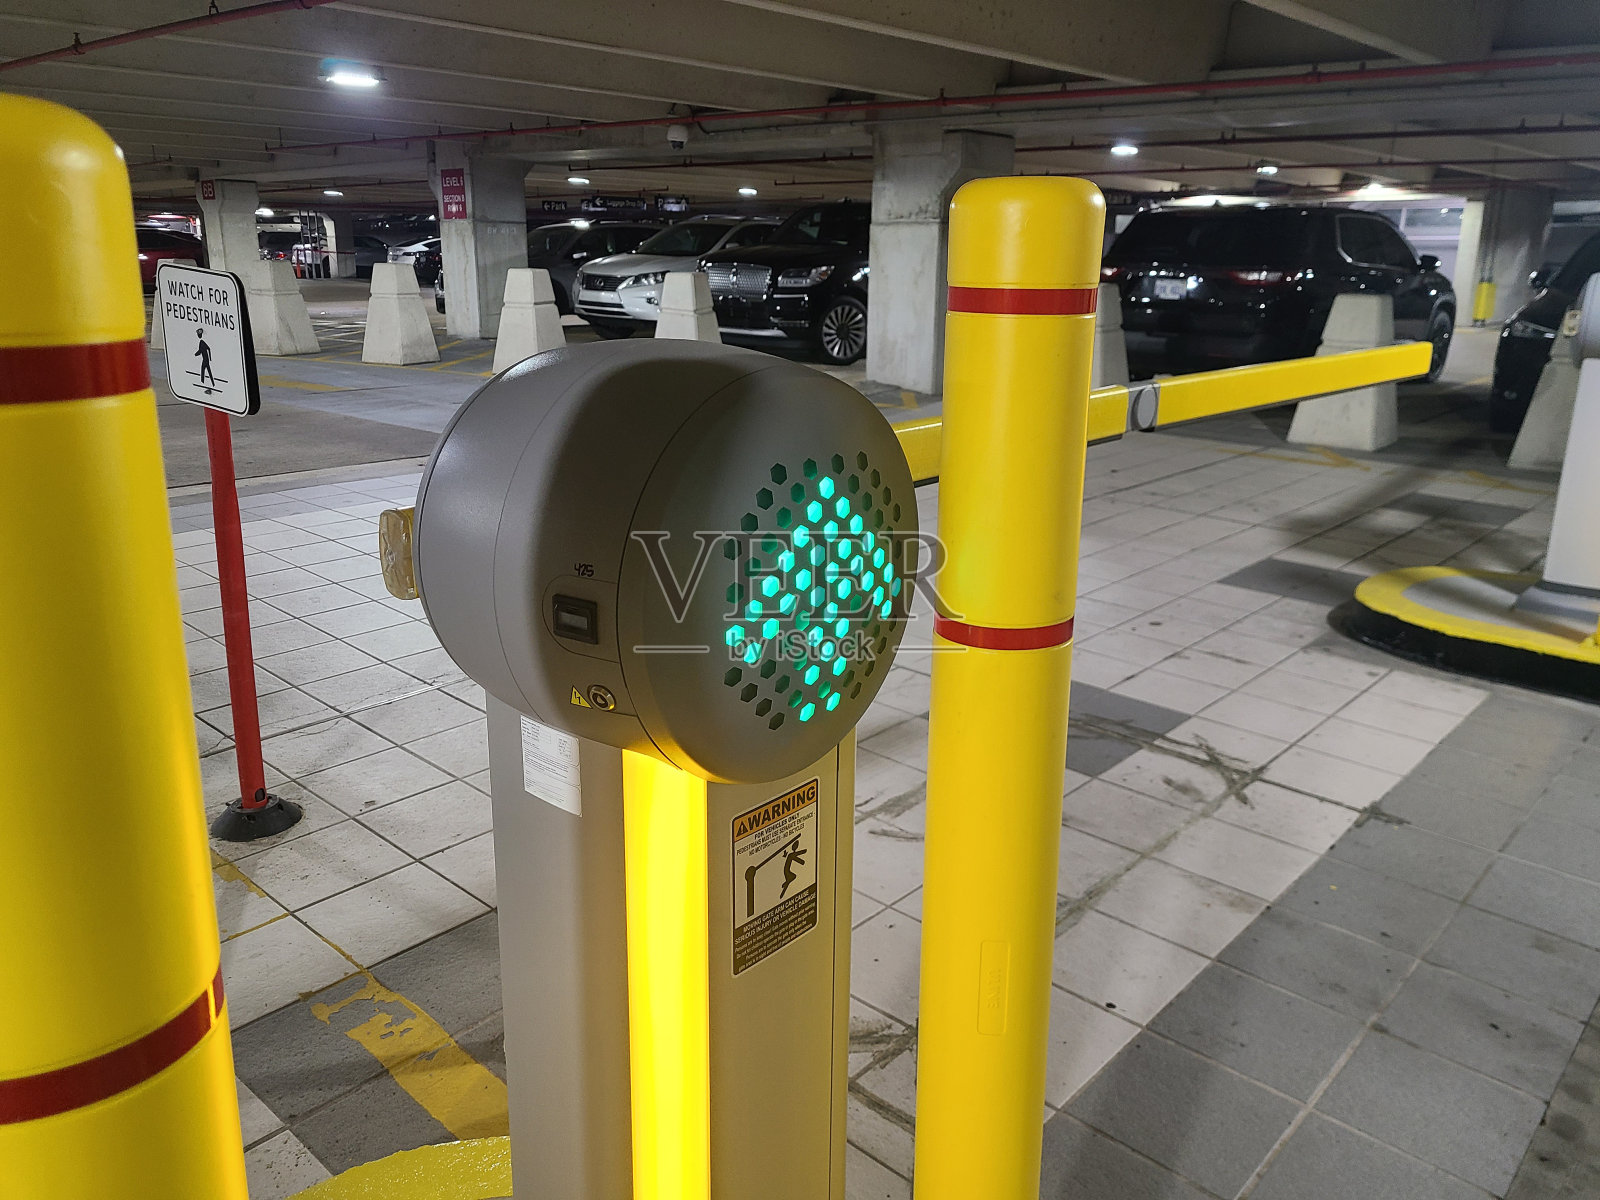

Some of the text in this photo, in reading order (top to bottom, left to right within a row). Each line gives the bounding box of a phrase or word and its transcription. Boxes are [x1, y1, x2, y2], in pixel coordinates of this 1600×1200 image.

[442, 177, 460, 187] LEVEL
[447, 204, 459, 212] RW
[167, 280, 229, 307] WATCH FOR
[166, 301, 235, 331] PEDESTRIANS
[574, 562, 595, 577] 425
[747, 785, 816, 831] WARNING
[754, 812, 800, 840] FOR VEHICLES ONLY
[736, 839, 762, 856] PEDESTRIANS
[762, 910, 774, 922] GATE
[735, 929, 756, 945] SERIOUS
